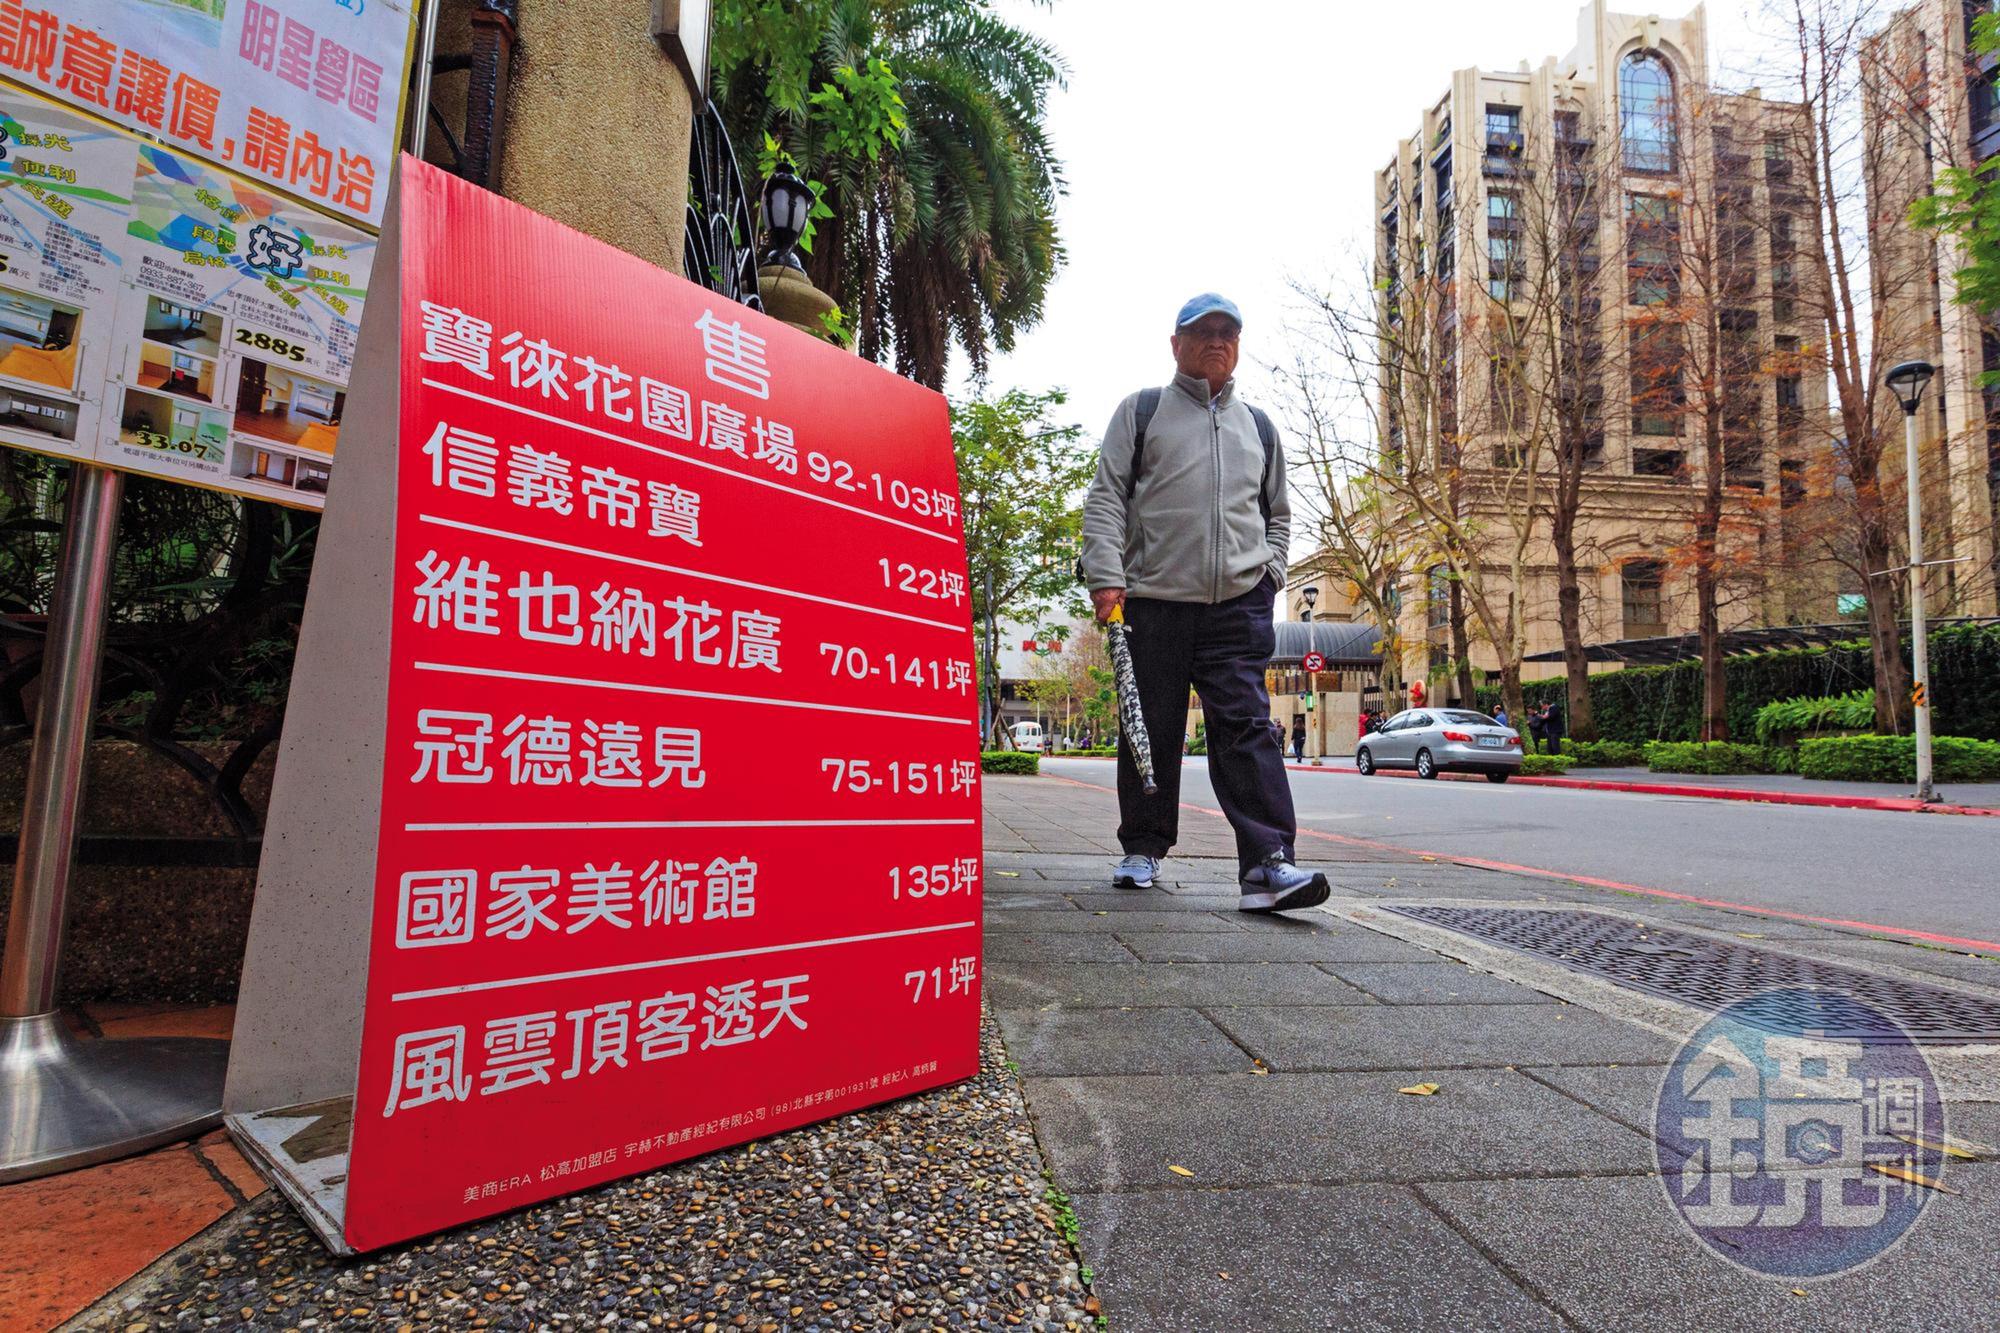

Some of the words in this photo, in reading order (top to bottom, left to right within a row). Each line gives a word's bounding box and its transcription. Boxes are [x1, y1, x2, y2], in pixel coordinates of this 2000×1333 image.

[239, 0, 384, 123] 明星學區
[22, 160, 77, 183] 便利
[246, 224, 304, 280] 好
[235, 328, 306, 362] 2885
[694, 309, 771, 400] 售
[419, 300, 799, 473] 寶徠花園廣場
[807, 452, 959, 527] 92-103坪
[422, 421, 703, 547] 信義帝寶
[412, 549, 783, 673] 維也納花廣
[819, 642, 972, 696] 70-141坪
[878, 557, 966, 607] 122坪
[410, 708, 706, 789] 冠德遠見
[820, 758, 977, 798] 75-151坪
[395, 856, 758, 949] 國家美術館
[888, 857, 979, 900] 135坪
[382, 974, 810, 1118] 風雲頂客透天
[904, 956, 976, 1004] 71坪
[463, 1174, 532, 1204] 美商ERA
[540, 1148, 618, 1181] 松高加盟店
[624, 1106, 766, 1158] 宇赫不動產經紀有限公司
[882, 1070, 909, 1086] 經紀人
